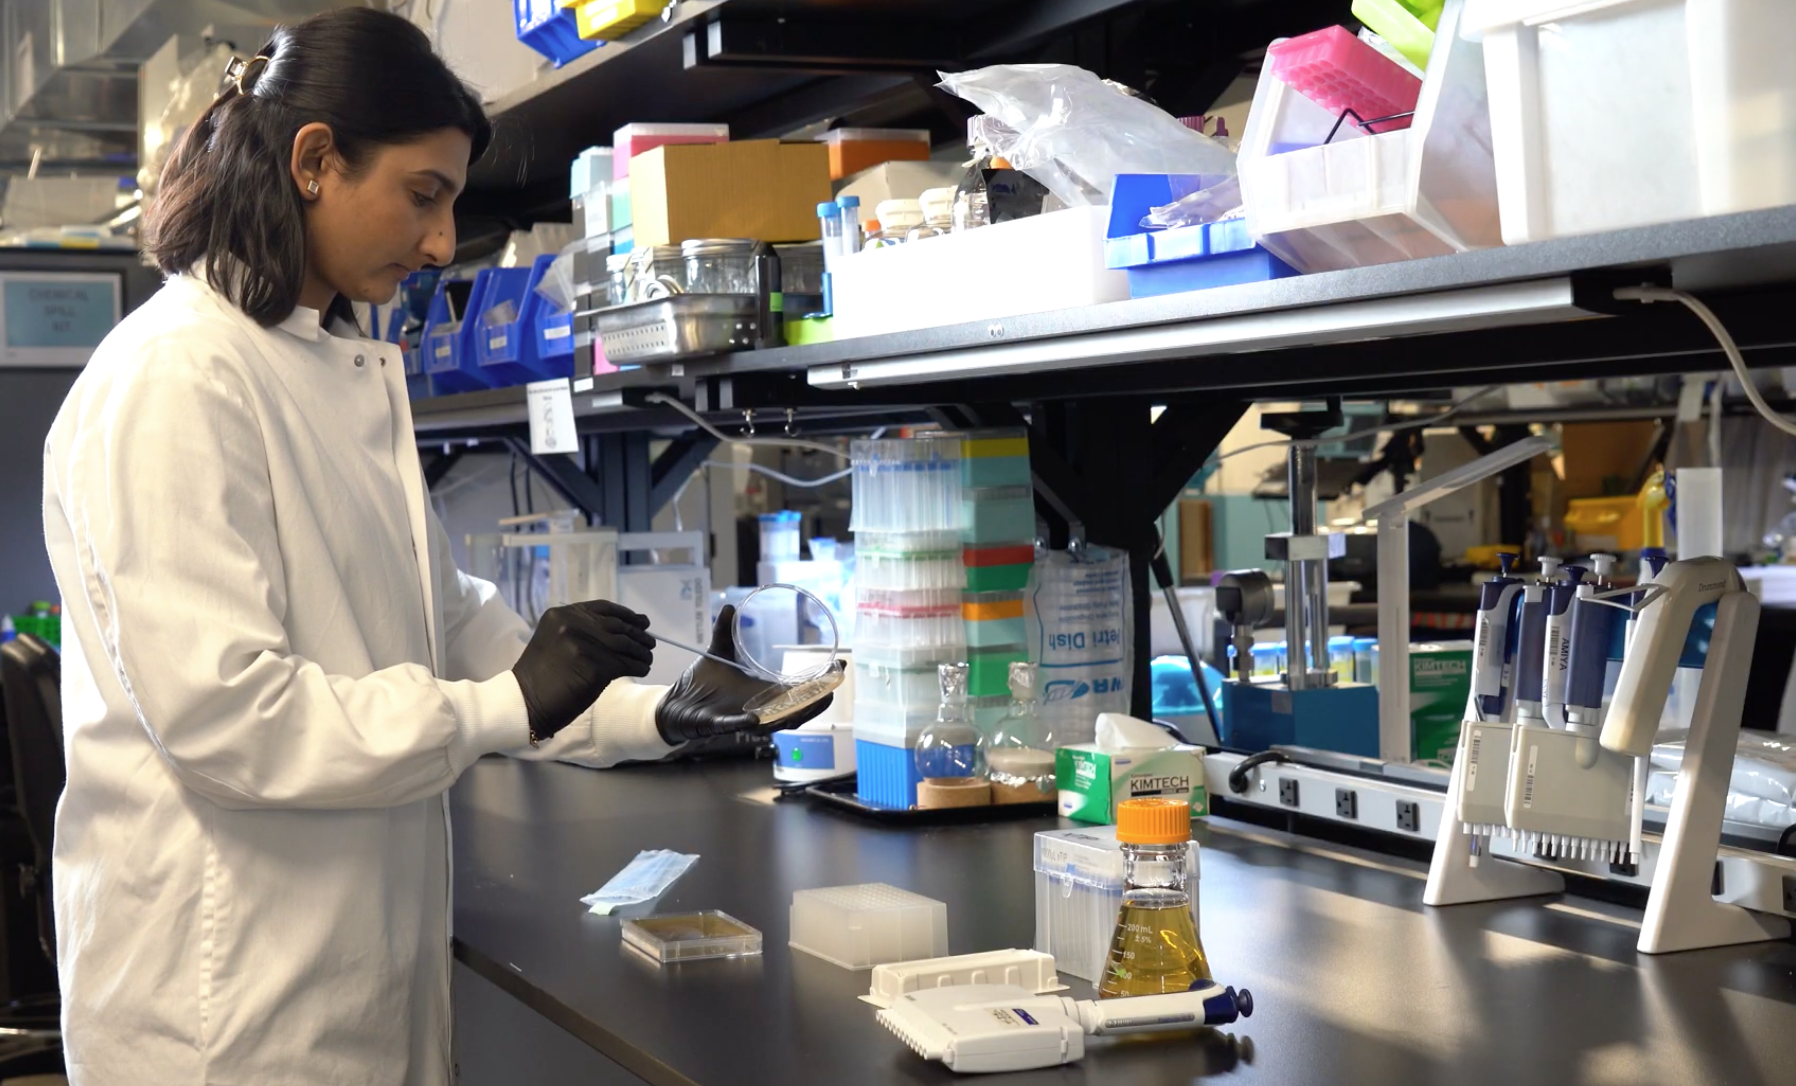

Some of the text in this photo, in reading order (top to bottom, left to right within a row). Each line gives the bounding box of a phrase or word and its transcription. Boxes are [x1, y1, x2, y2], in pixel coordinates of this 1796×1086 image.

[1048, 632, 1086, 651] Dish
[1559, 637, 1569, 671] AMIYA
[1093, 677, 1122, 693] WR
[1130, 776, 1189, 791] KIMTECH
[1127, 923, 1153, 934] 200 mL
[1123, 951, 1135, 959] 150
[1120, 990, 1130, 998] 50
